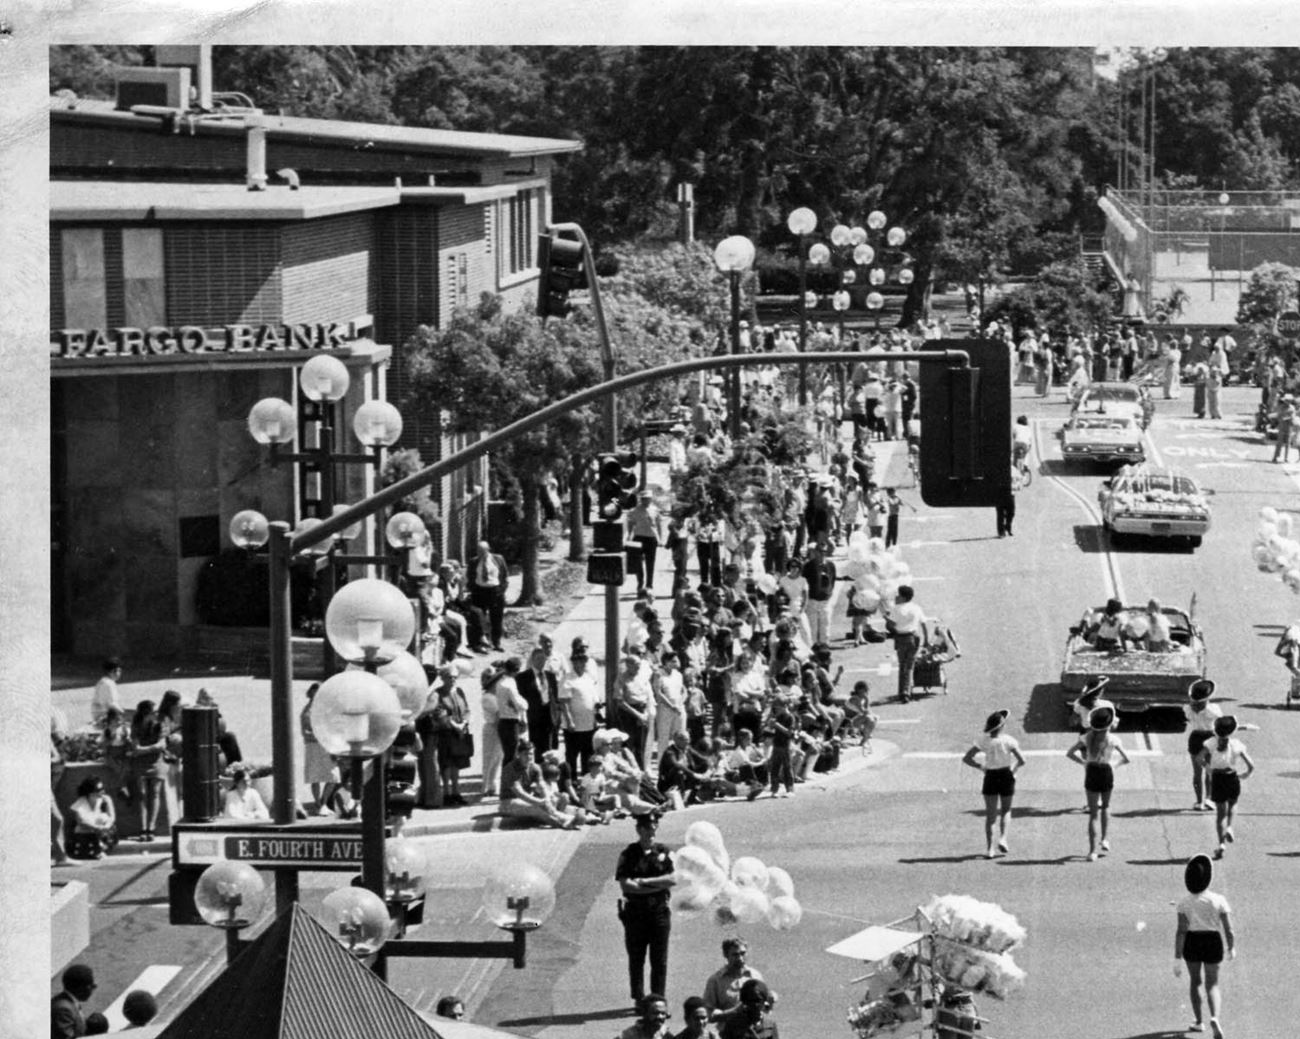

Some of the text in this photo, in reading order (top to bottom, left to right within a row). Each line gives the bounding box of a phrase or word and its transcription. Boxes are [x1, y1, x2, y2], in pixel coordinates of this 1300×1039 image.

[62, 323, 353, 358] FARGO BANK
[1162, 446, 1251, 459] ONLY
[239, 839, 253, 858] E.
[258, 840, 323, 858] FOURTH
